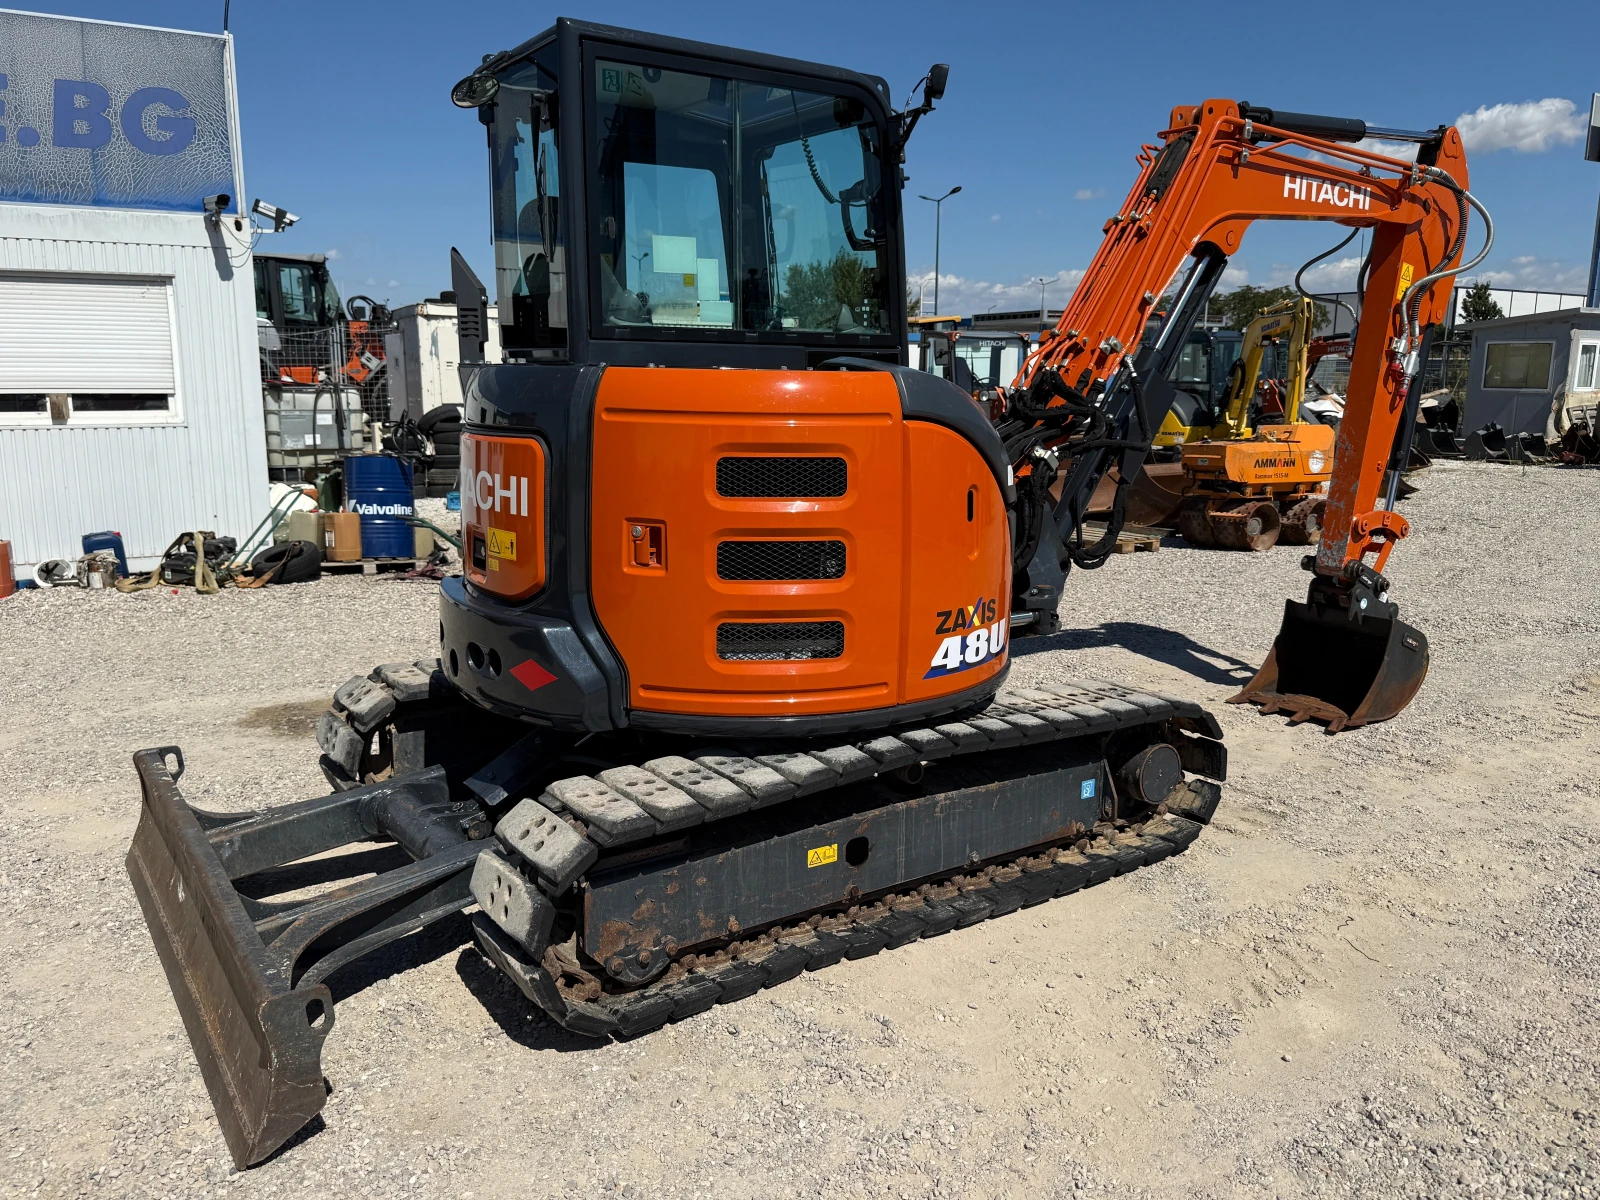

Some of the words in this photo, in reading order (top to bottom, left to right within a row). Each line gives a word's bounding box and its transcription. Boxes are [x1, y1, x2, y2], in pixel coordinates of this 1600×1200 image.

[0, 74, 196, 156] .BG
[1283, 173, 1371, 210] HITACHI
[1327, 344, 1348, 352] HITAC
[1254, 458, 1296, 468] AMMANN
[356, 504, 413, 515] Valvoline
[935, 597, 997, 635] ZAXIS
[930, 617, 1006, 671] 48U
